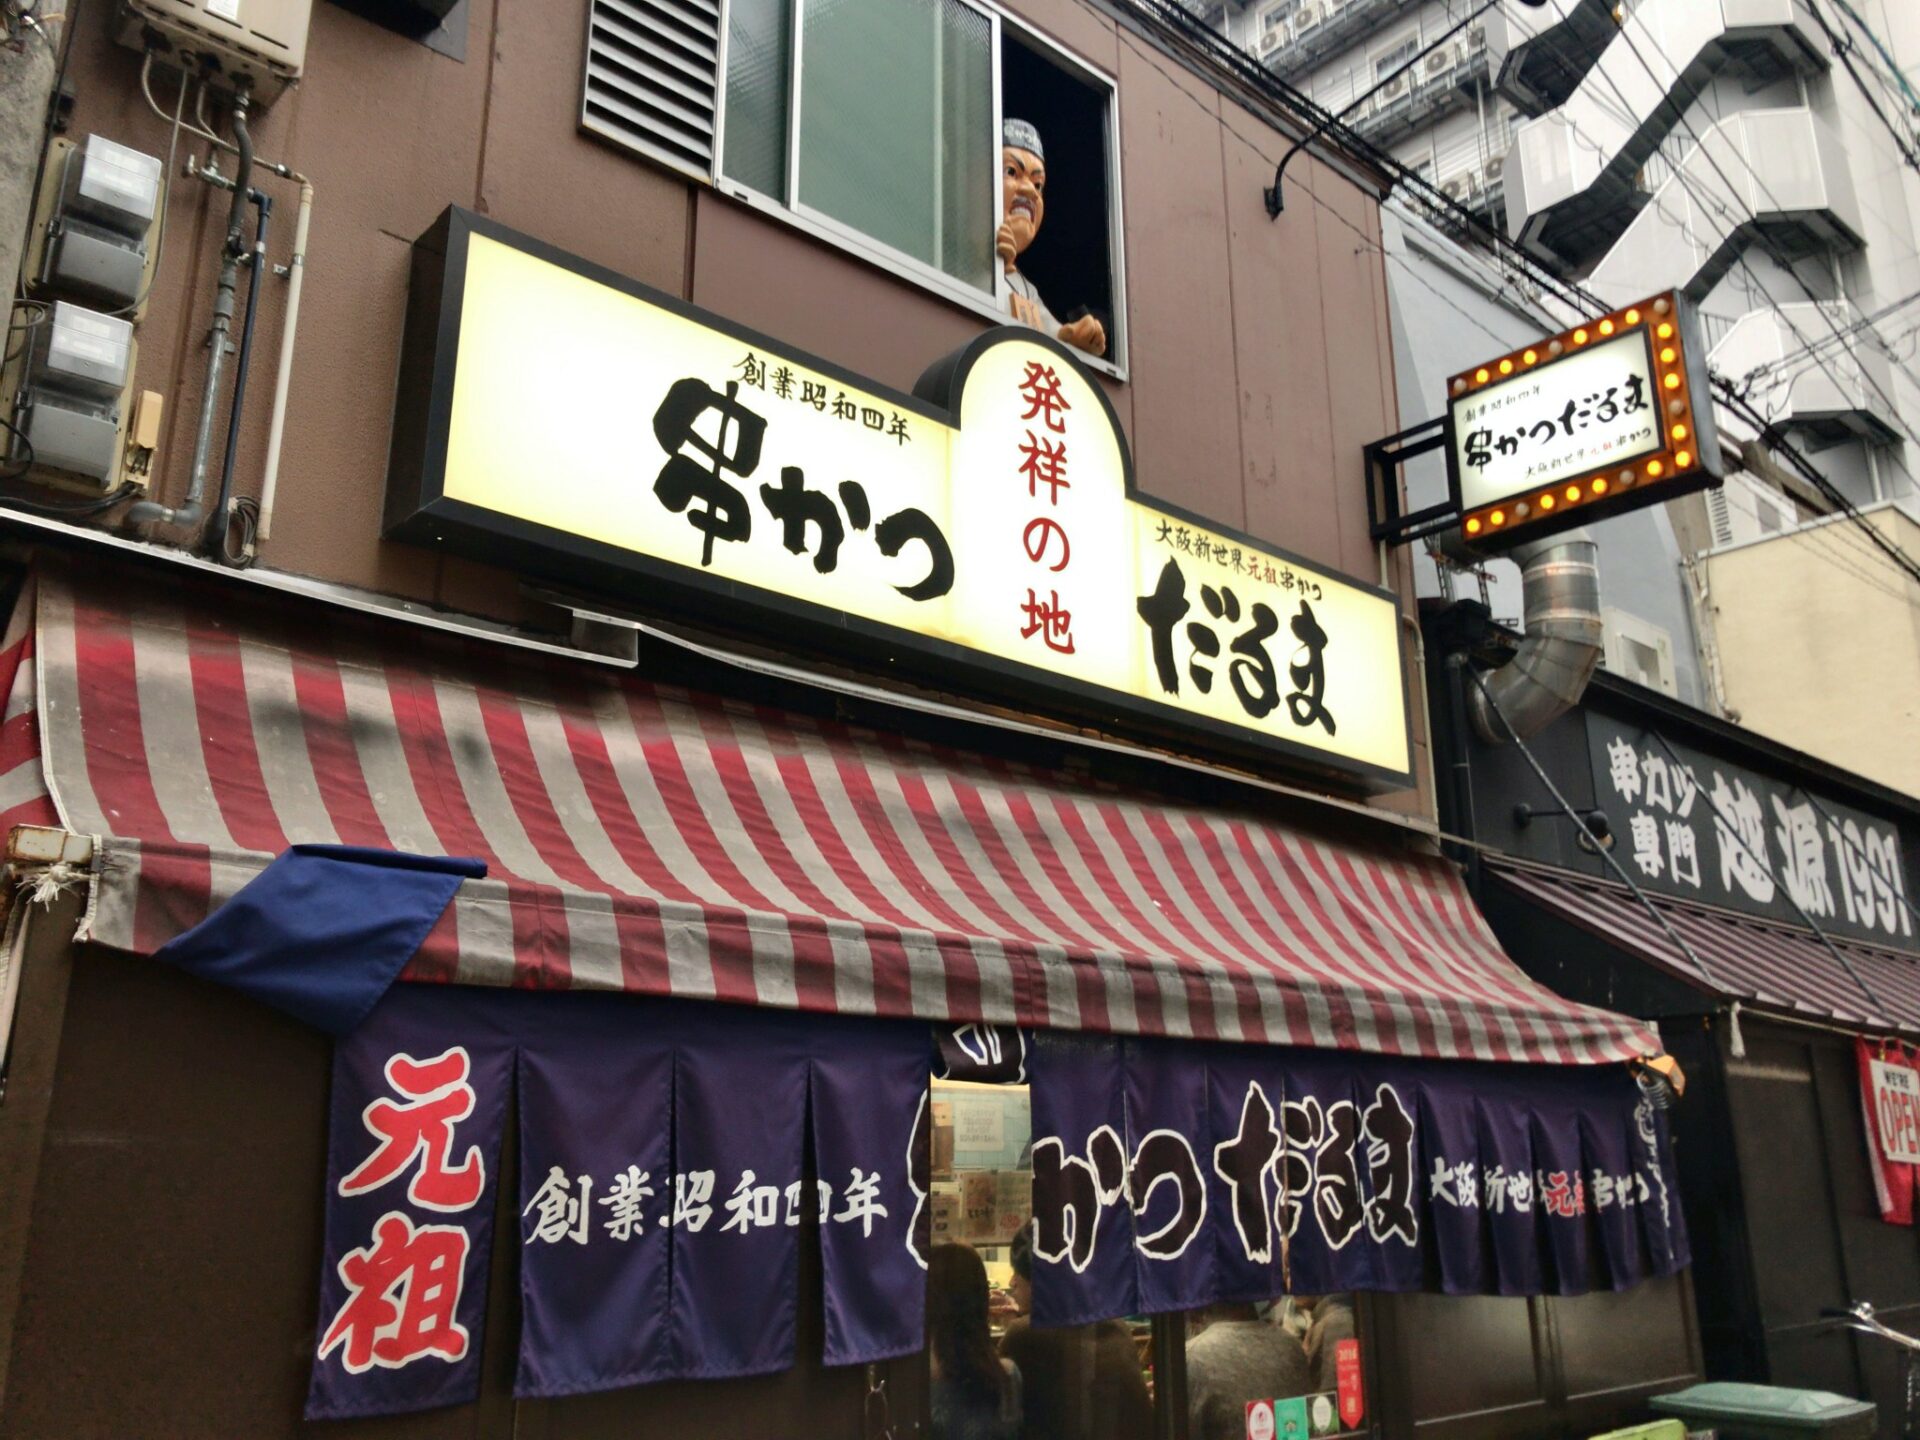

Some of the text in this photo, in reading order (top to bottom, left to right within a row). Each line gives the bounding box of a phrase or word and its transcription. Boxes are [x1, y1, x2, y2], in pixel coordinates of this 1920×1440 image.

[733, 352, 911, 446] 創業昭和四年
[1464, 373, 1649, 475] 串かつだるま
[1018, 360, 1075, 655] 発祥の地
[653, 377, 1336, 736] 串かつ だるま
[1155, 518, 1322, 601] 大阪新世界元祖串かつ
[1606, 735, 1697, 818] 串カツ
[1629, 808, 1702, 888] 専門
[317, 1046, 486, 1375] 元祖
[523, 1164, 889, 1246] 創業昭和四年
